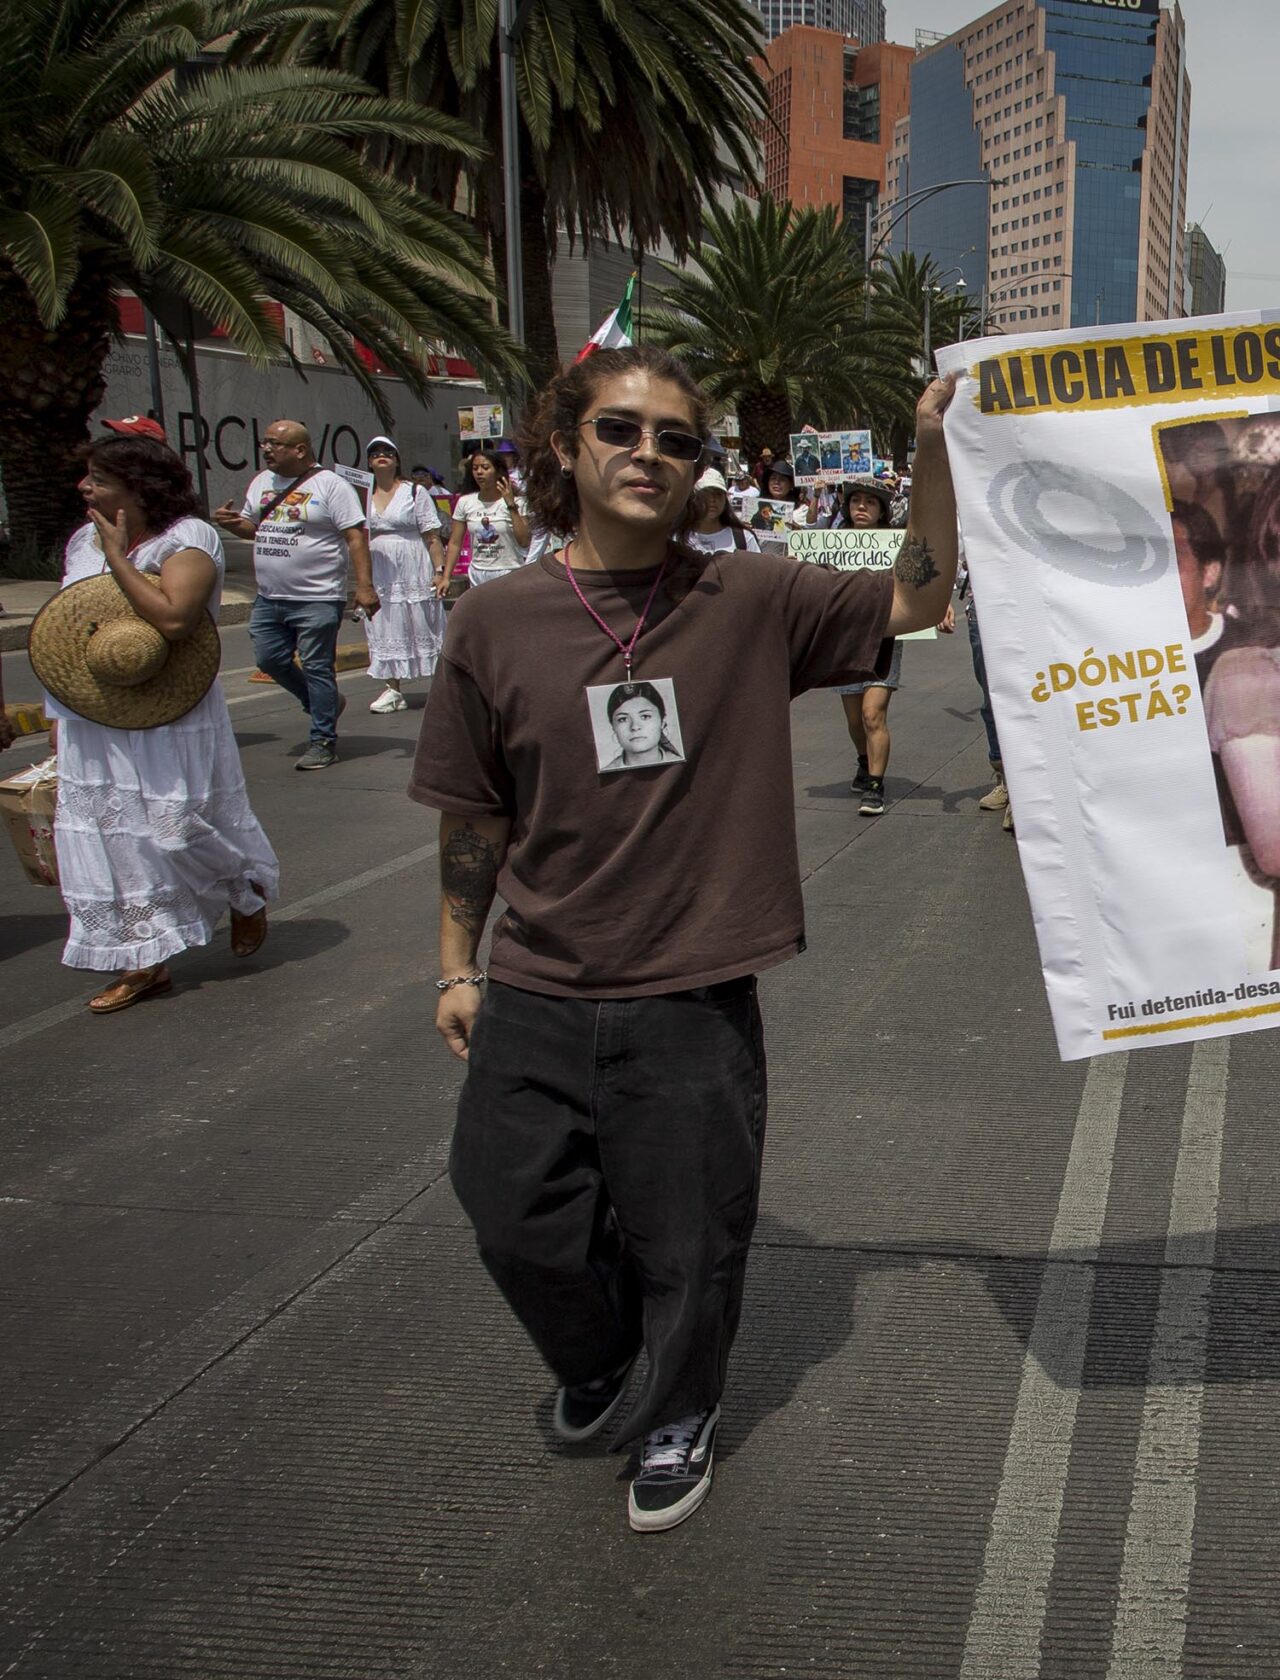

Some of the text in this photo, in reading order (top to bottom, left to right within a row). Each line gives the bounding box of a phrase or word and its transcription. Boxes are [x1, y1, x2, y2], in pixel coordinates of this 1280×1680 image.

[979, 346, 1136, 413] ALICIA
[1142, 338, 1203, 394] DE
[1031, 643, 1187, 703] ¿DÓNDE
[1075, 679, 1192, 732] ESTÁ?
[1107, 1003, 1136, 1021] Fui
